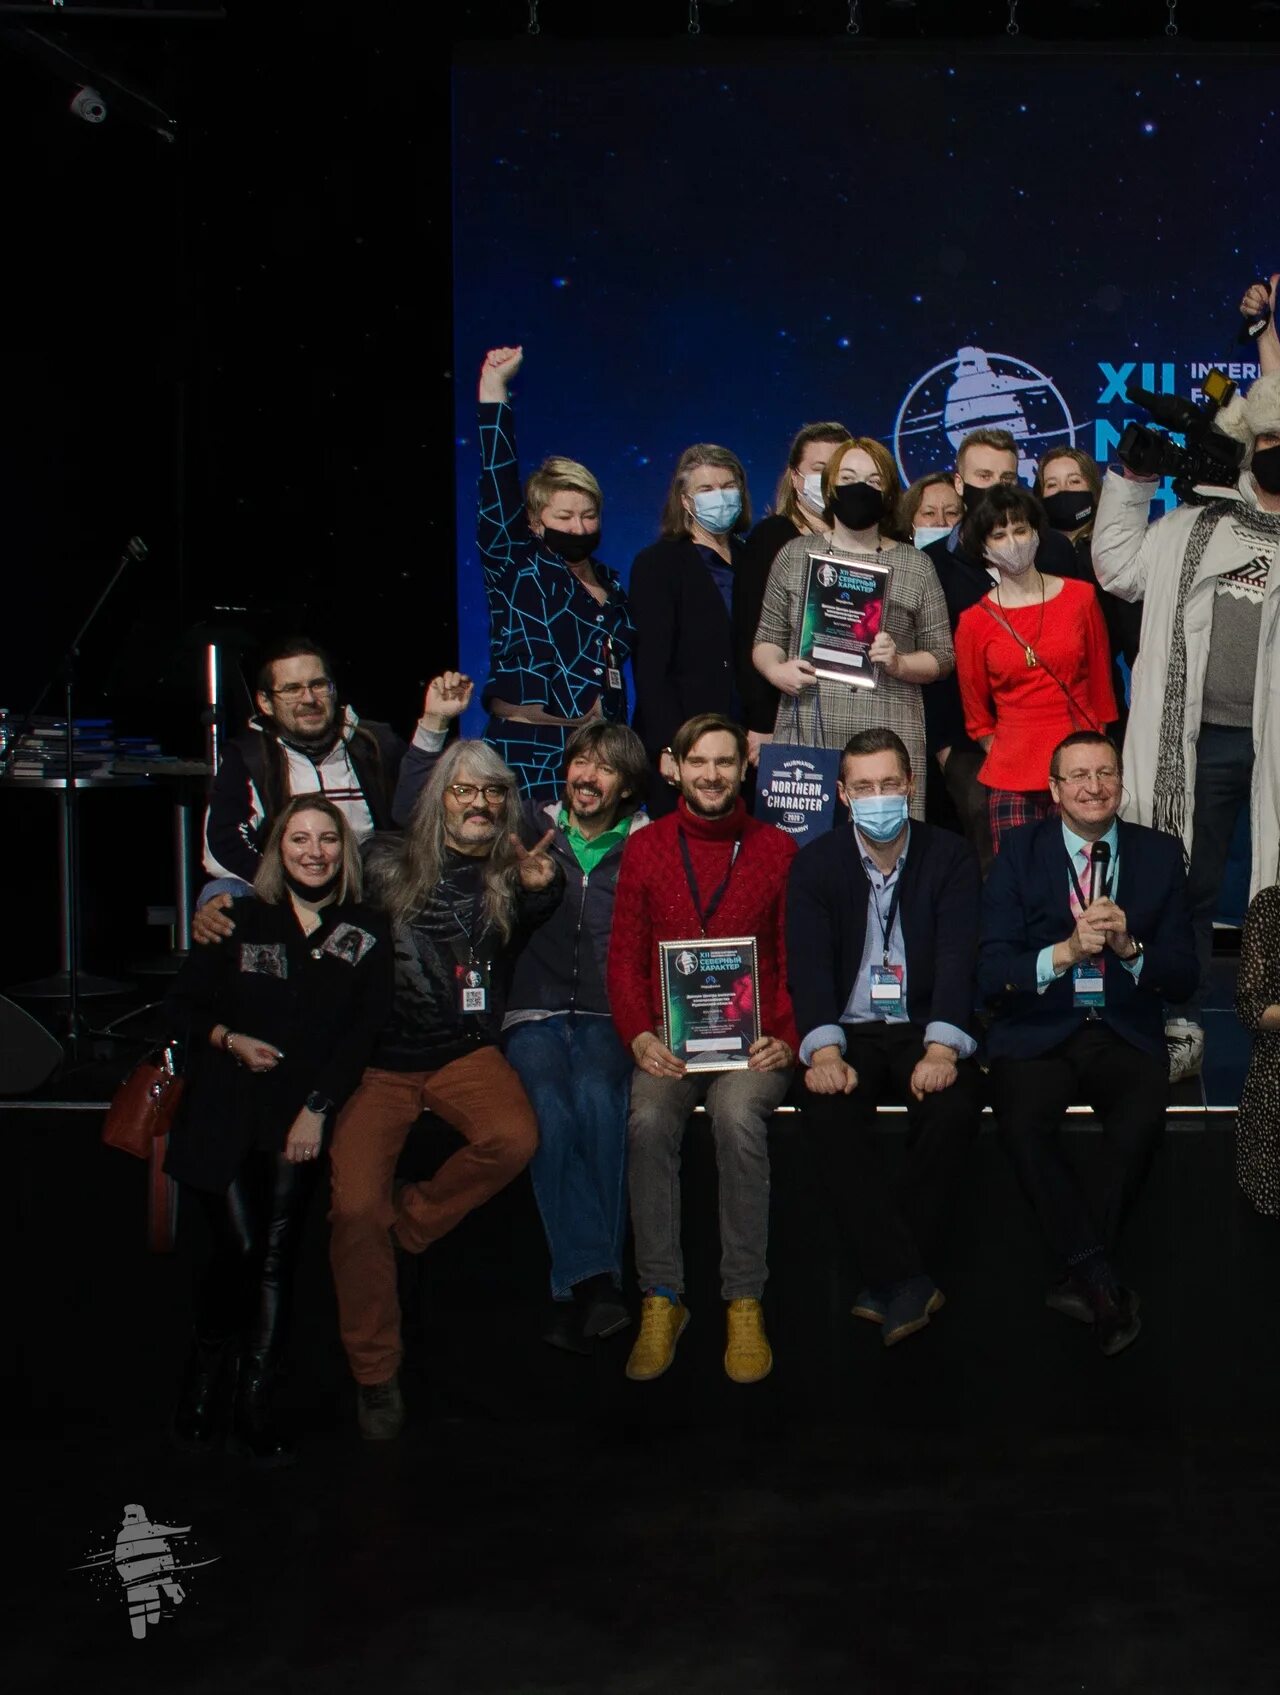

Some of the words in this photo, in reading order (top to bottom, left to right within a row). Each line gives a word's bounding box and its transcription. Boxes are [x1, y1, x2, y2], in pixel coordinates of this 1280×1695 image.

[771, 780, 822, 796] NORTHERN
[767, 795, 823, 811] CHARACTER
[700, 955, 742, 965] СЕВЕРНЫЙ
[700, 963, 740, 972] ХАРАКТЕР
